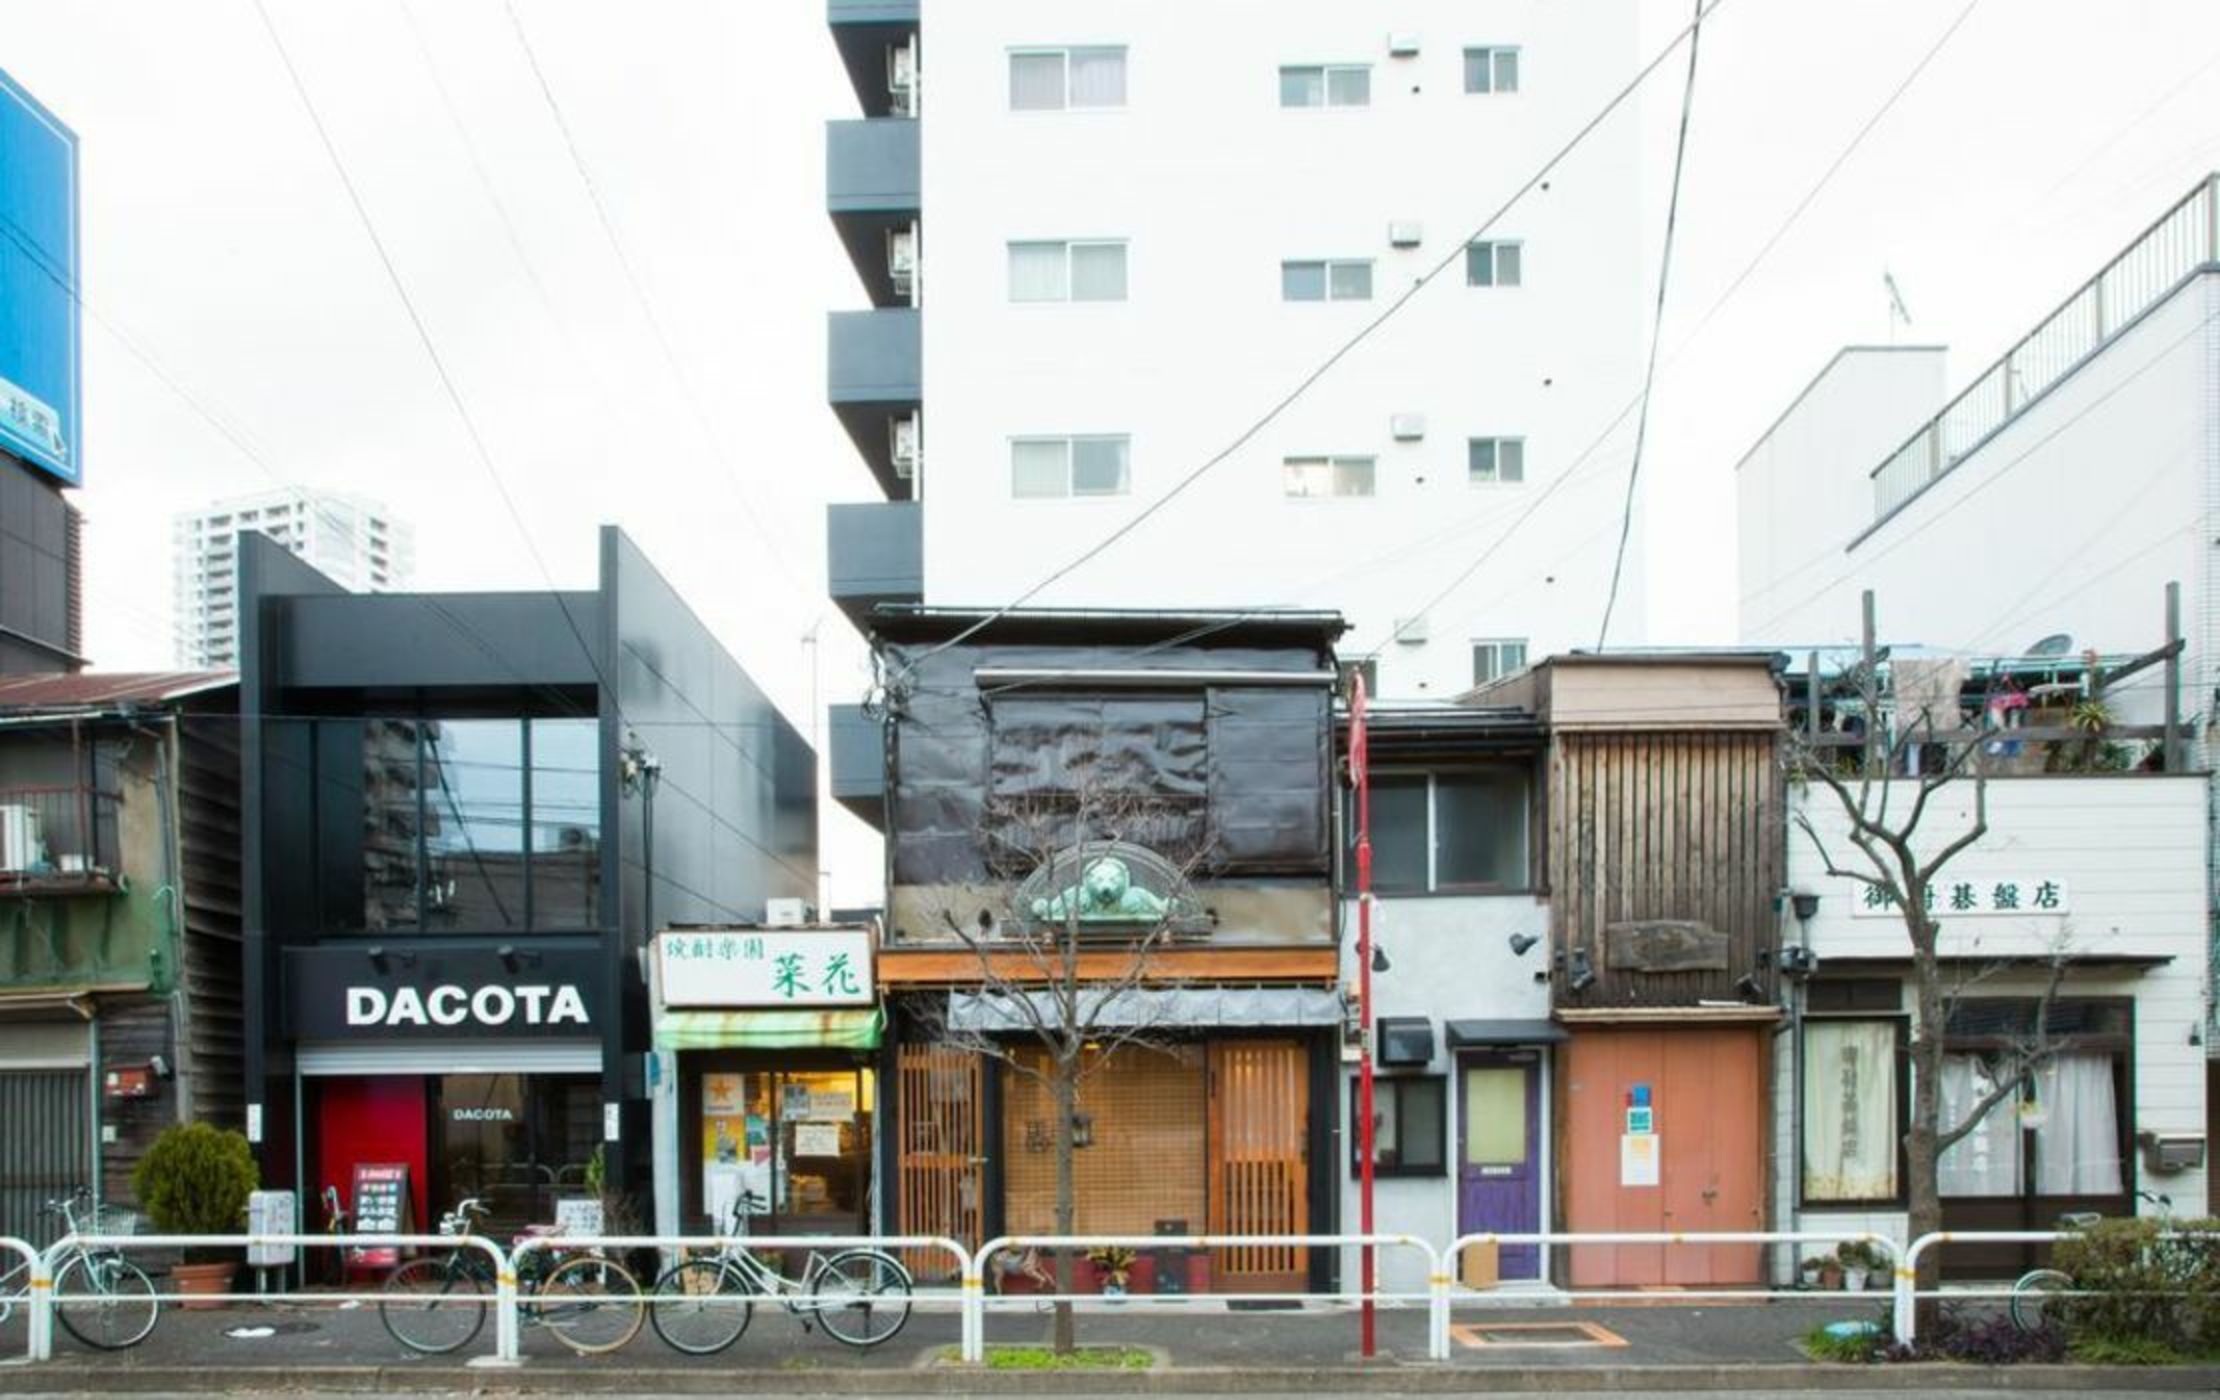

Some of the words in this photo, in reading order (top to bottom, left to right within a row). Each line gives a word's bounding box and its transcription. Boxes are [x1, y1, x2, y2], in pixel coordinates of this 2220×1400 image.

[771, 952, 861, 998] 菜花
[346, 985, 590, 1025] DACOTA
[453, 1108, 513, 1121] DACOTA
